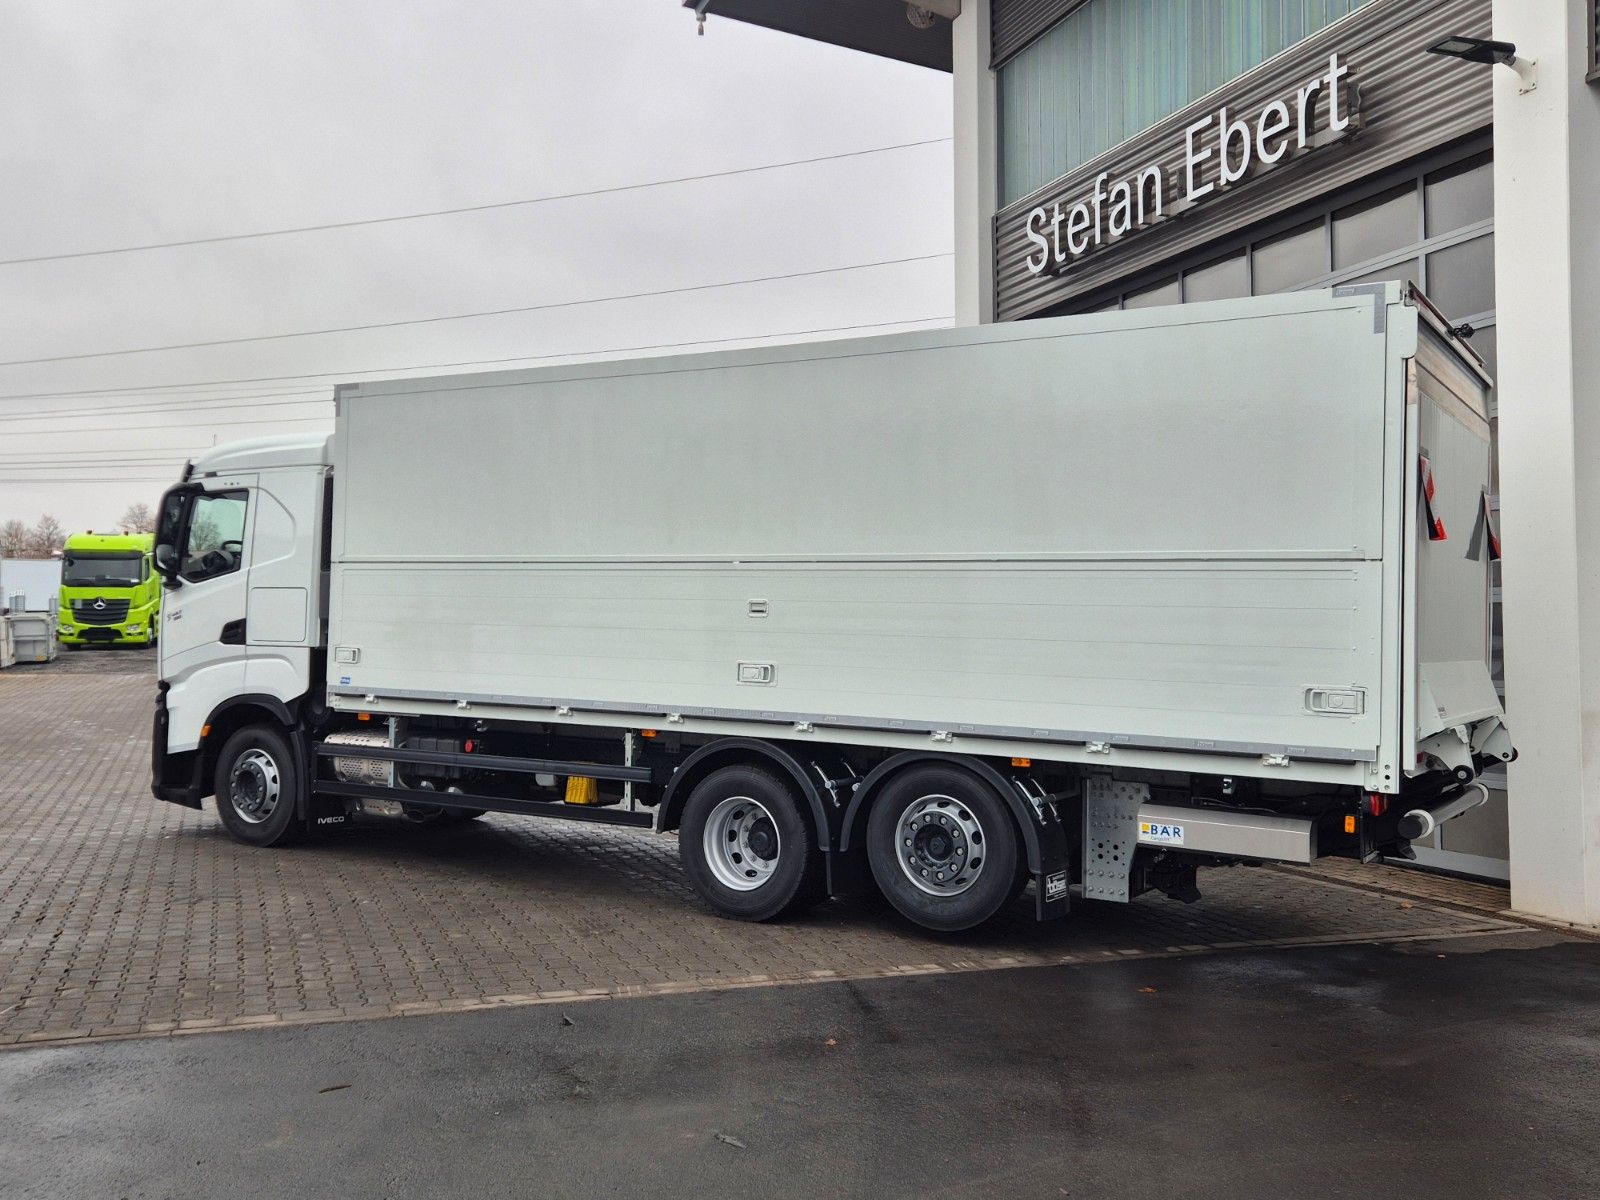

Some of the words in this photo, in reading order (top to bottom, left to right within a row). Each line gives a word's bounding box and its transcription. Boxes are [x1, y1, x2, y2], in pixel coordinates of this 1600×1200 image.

[1026, 165, 1163, 274] Stefan
[1186, 52, 1349, 201] Ebert
[317, 816, 345, 825] IVECO
[1150, 824, 1181, 837] BÄR
